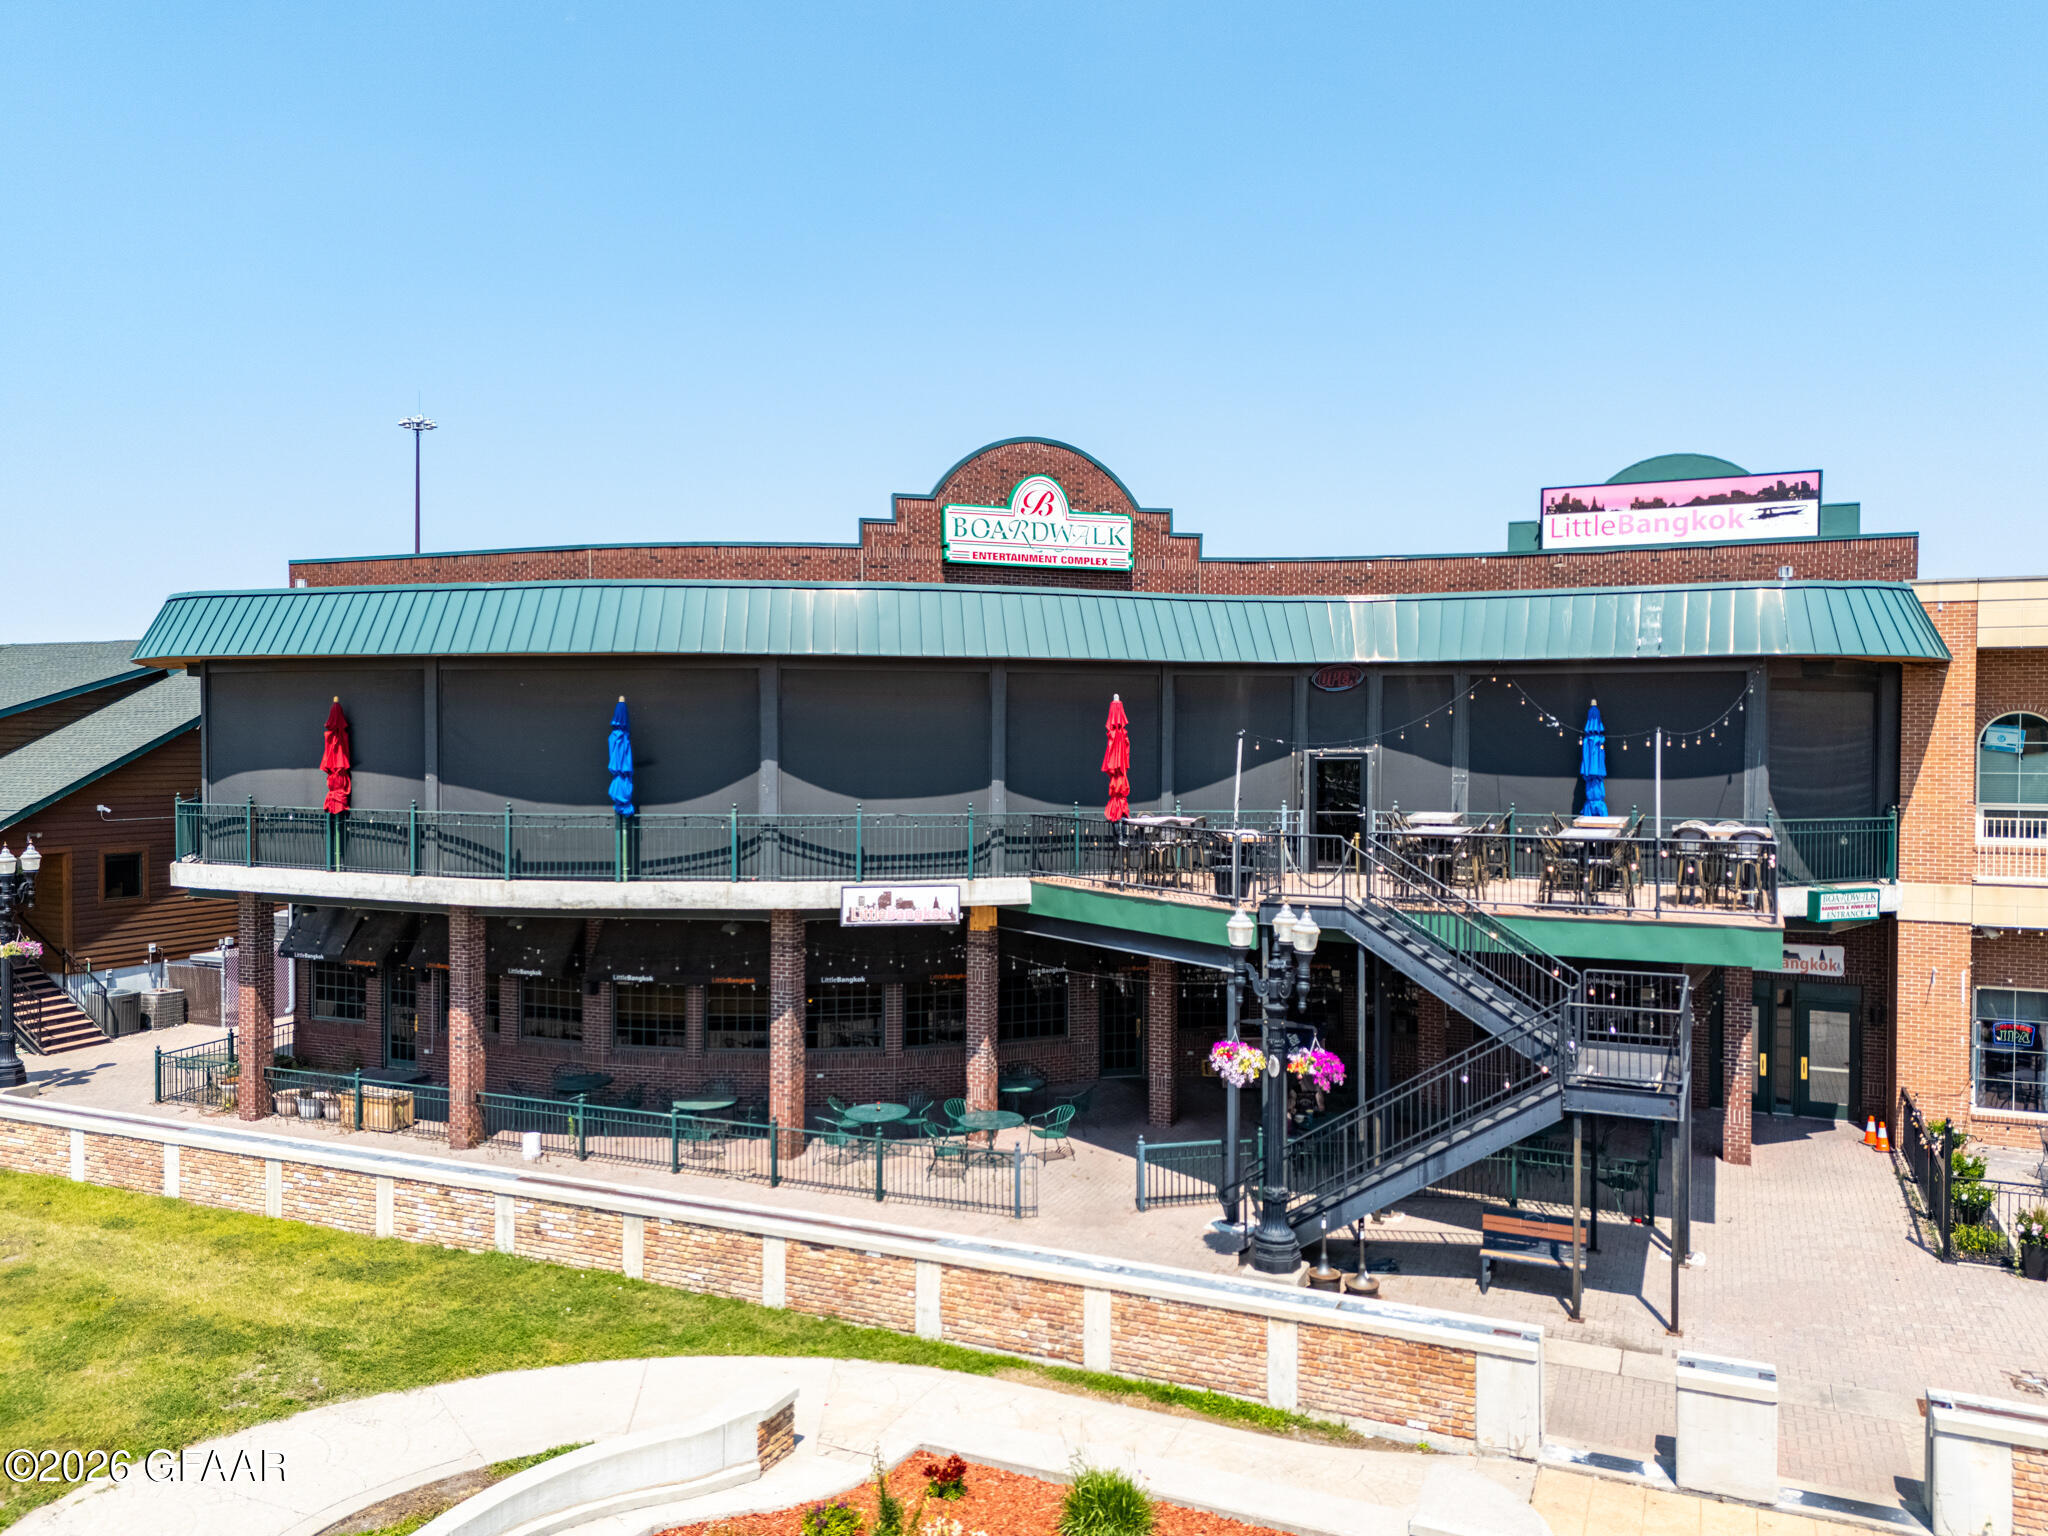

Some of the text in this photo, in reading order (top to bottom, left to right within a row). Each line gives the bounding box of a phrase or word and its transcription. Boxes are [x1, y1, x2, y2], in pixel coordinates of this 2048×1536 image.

[1020, 490, 1055, 517] B
[1551, 508, 1745, 538] LittleBangkok
[952, 516, 1127, 550] BOARDWALK
[972, 551, 1109, 567] ENTERTAINMENT COMPLEX
[850, 906, 949, 923] LittleBangkok
[1827, 910, 1865, 919] ENTRANCE
[293, 951, 325, 961] LittleBangkok
[508, 967, 543, 977] LittleBangkok
[612, 973, 654, 983] LittleBangkok
[820, 976, 867, 985] LittleBangkok
